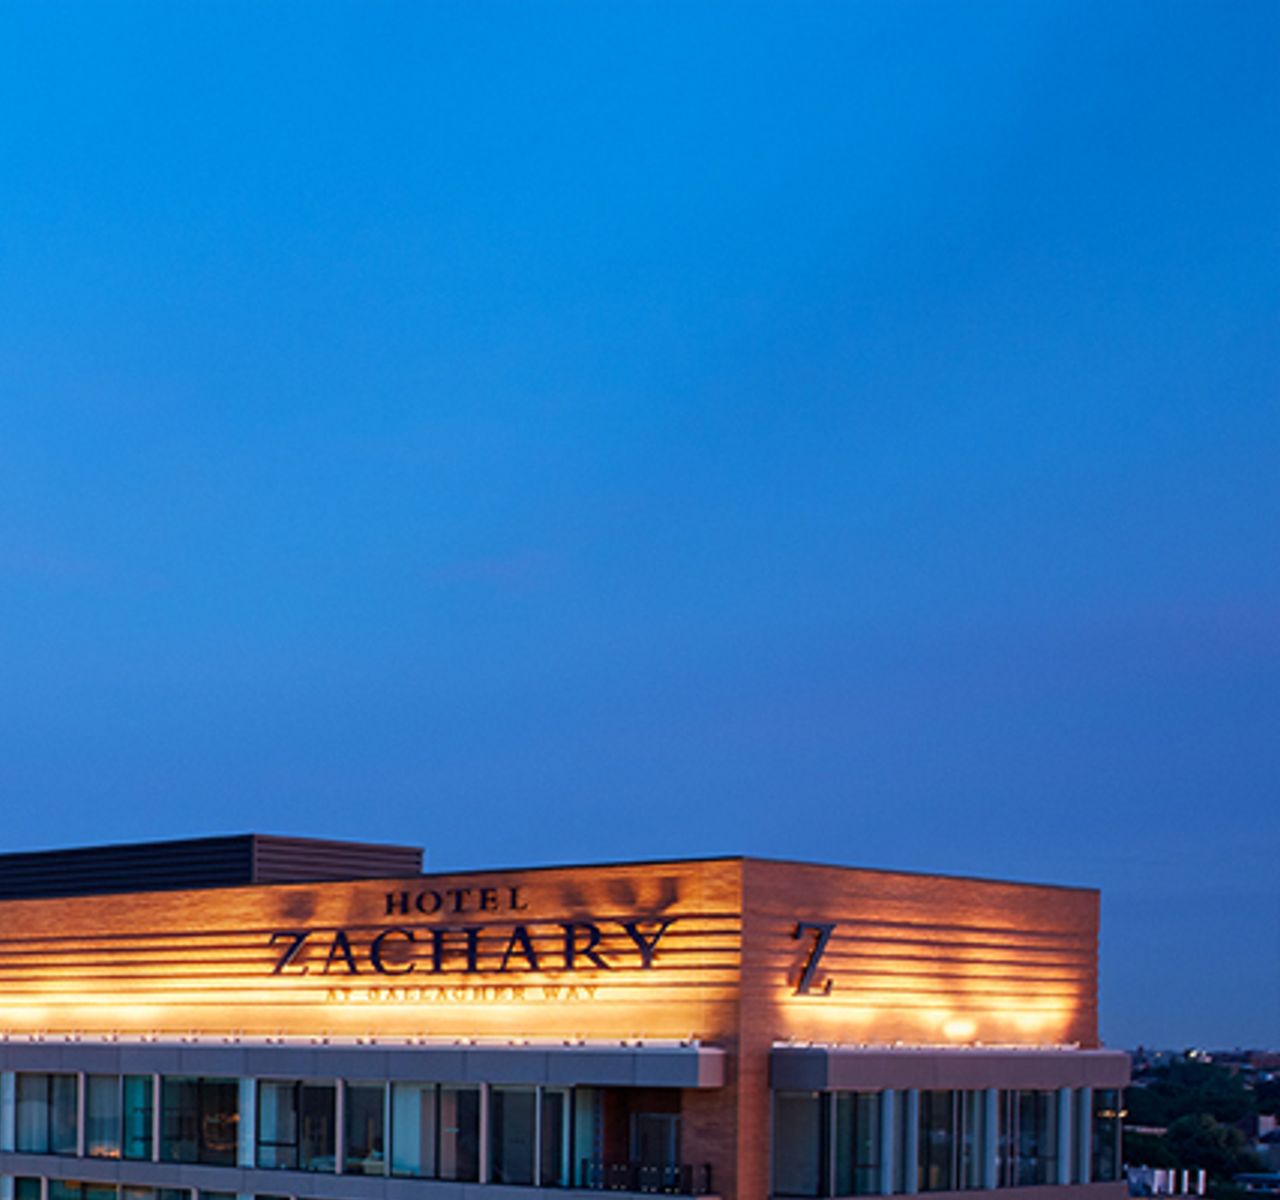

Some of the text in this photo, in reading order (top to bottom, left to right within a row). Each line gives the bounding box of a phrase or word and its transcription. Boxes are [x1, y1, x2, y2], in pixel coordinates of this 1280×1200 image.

[384, 887, 528, 916] HOTEL
[268, 919, 678, 977] ZACHARY
[792, 922, 837, 996] Z
